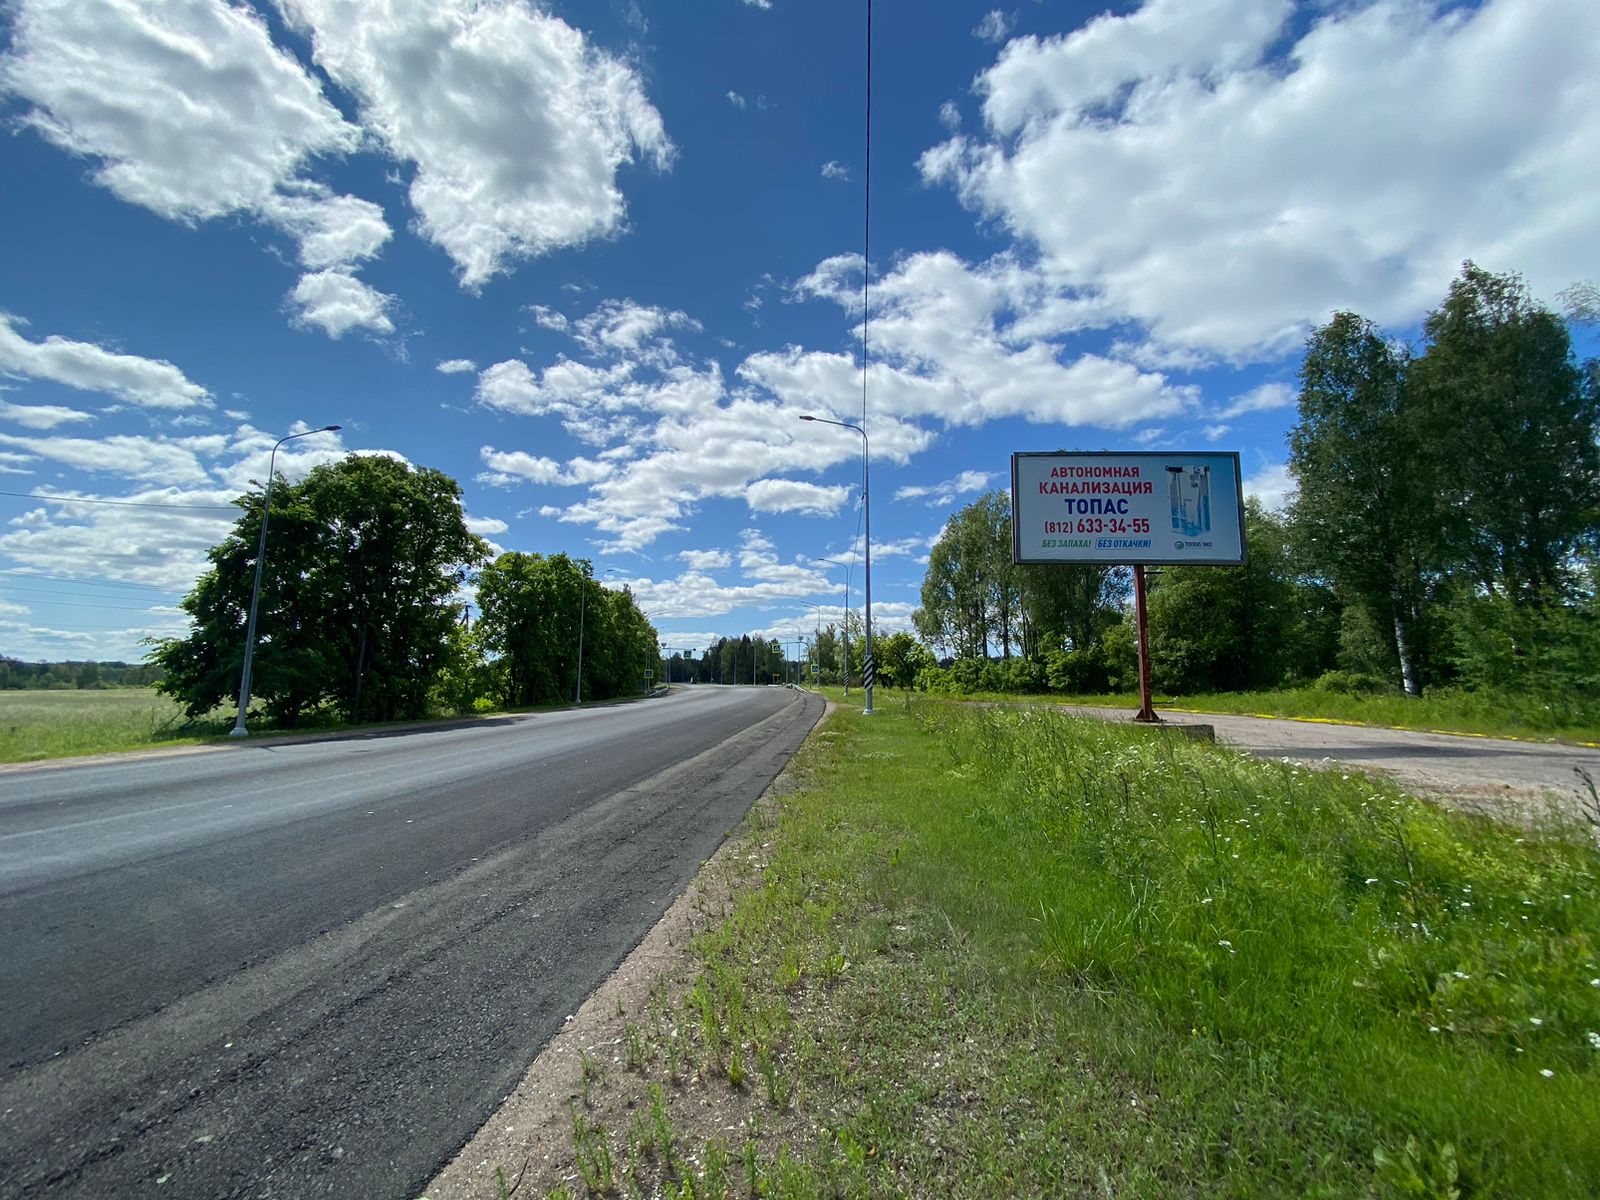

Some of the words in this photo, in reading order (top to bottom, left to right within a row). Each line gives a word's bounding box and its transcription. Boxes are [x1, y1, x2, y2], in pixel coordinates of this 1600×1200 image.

[1051, 466, 1140, 478] АВТОНОМНАЯ
[1039, 481, 1153, 496] КАНАЛИЗАЦИЯ
[1064, 498, 1129, 515] ТОПАС
[1044, 520, 1073, 534] (812)
[1077, 518, 1150, 533] 633-34-55
[1042, 539, 1057, 548] БЕЗ
[1057, 539, 1092, 548] ЗАПАХА!
[1097, 539, 1113, 548] БЕЗ
[1113, 539, 1151, 548] ОТКАЧКИ!
